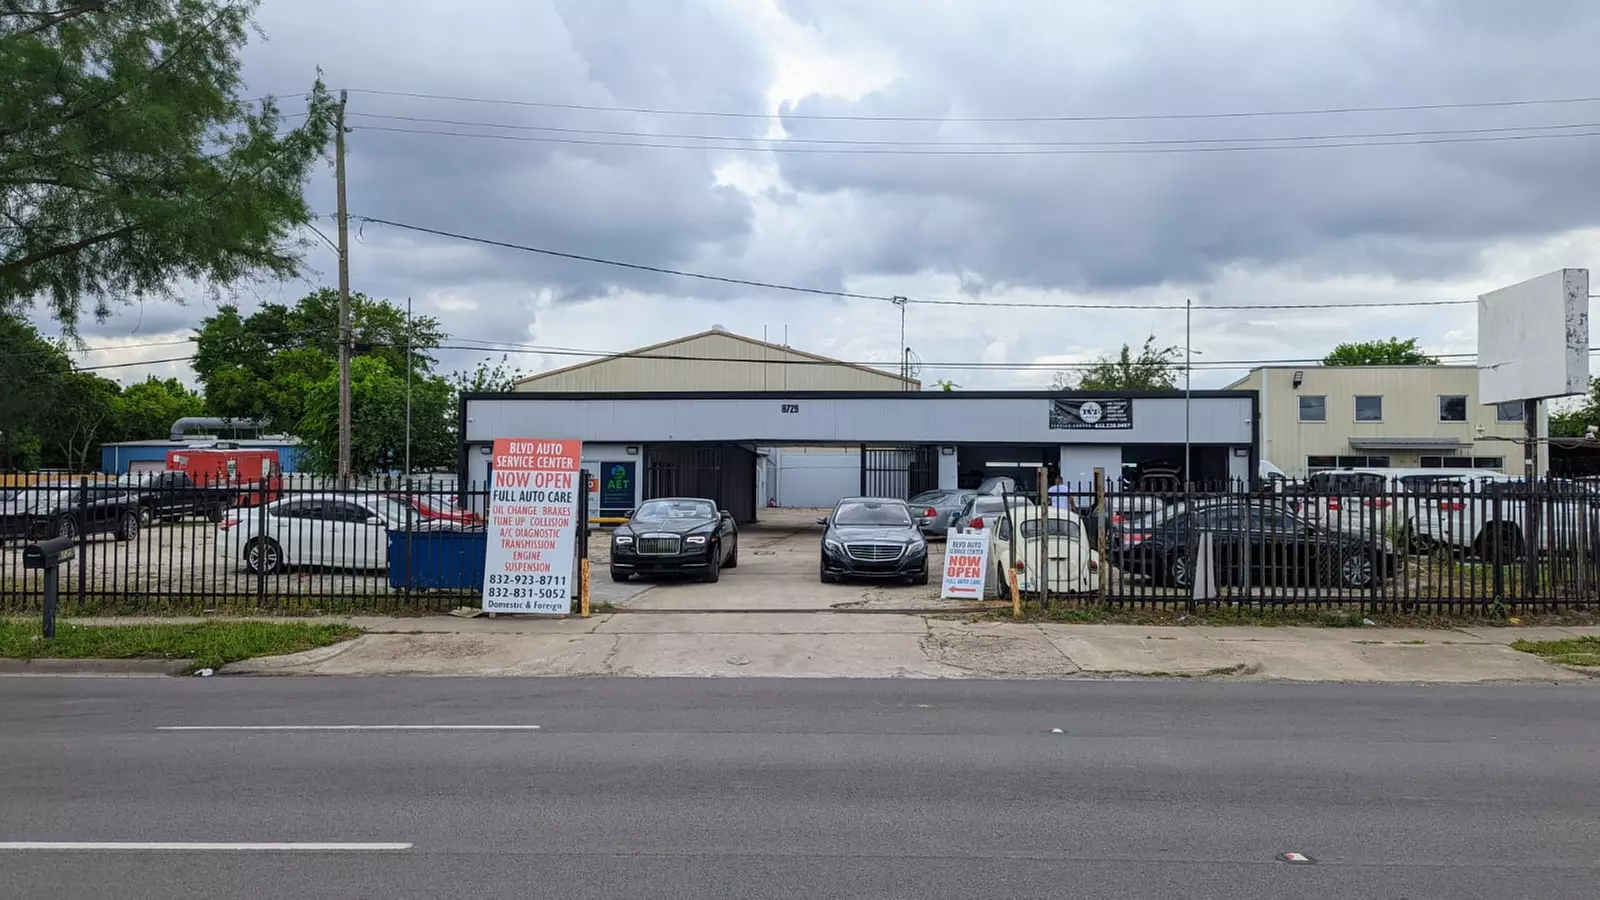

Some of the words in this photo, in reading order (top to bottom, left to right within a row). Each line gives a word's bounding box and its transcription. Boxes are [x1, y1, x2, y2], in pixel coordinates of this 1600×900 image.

[781, 404, 799, 413] 8729
[509, 442, 534, 454] BLVD
[537, 443, 562, 454] AUTO
[496, 455, 534, 468] SERVICE
[537, 457, 573, 468] CENTER
[496, 472, 530, 488] NOW
[535, 473, 571, 488] OPEN
[608, 480, 629, 488] AET
[494, 490, 516, 501] FULL
[519, 491, 545, 502] AUTO
[548, 492, 572, 503] CARE
[493, 505, 504, 514] OIL
[507, 505, 537, 515] CHANGE
[542, 506, 571, 516] BRAKES
[494, 517, 512, 526] TUNE
[515, 517, 525, 526] UP
[530, 517, 569, 527] COLLISION
[500, 528, 513, 537] A/C
[516, 529, 560, 538] DIAGNOSTIC
[501, 540, 556, 549] TRANSMISSION
[513, 551, 541, 560] ENGINE
[949, 556, 981, 567] NOW
[504, 563, 551, 572] SUSPENSION
[947, 567, 980, 578] OPEN
[489, 574, 566, 586] 832-923-8711
[488, 587, 566, 599] 832-831-5052
[488, 600, 523, 609] Domestic
[525, 601, 531, 609] &
[534, 602, 562, 612] Foreign
